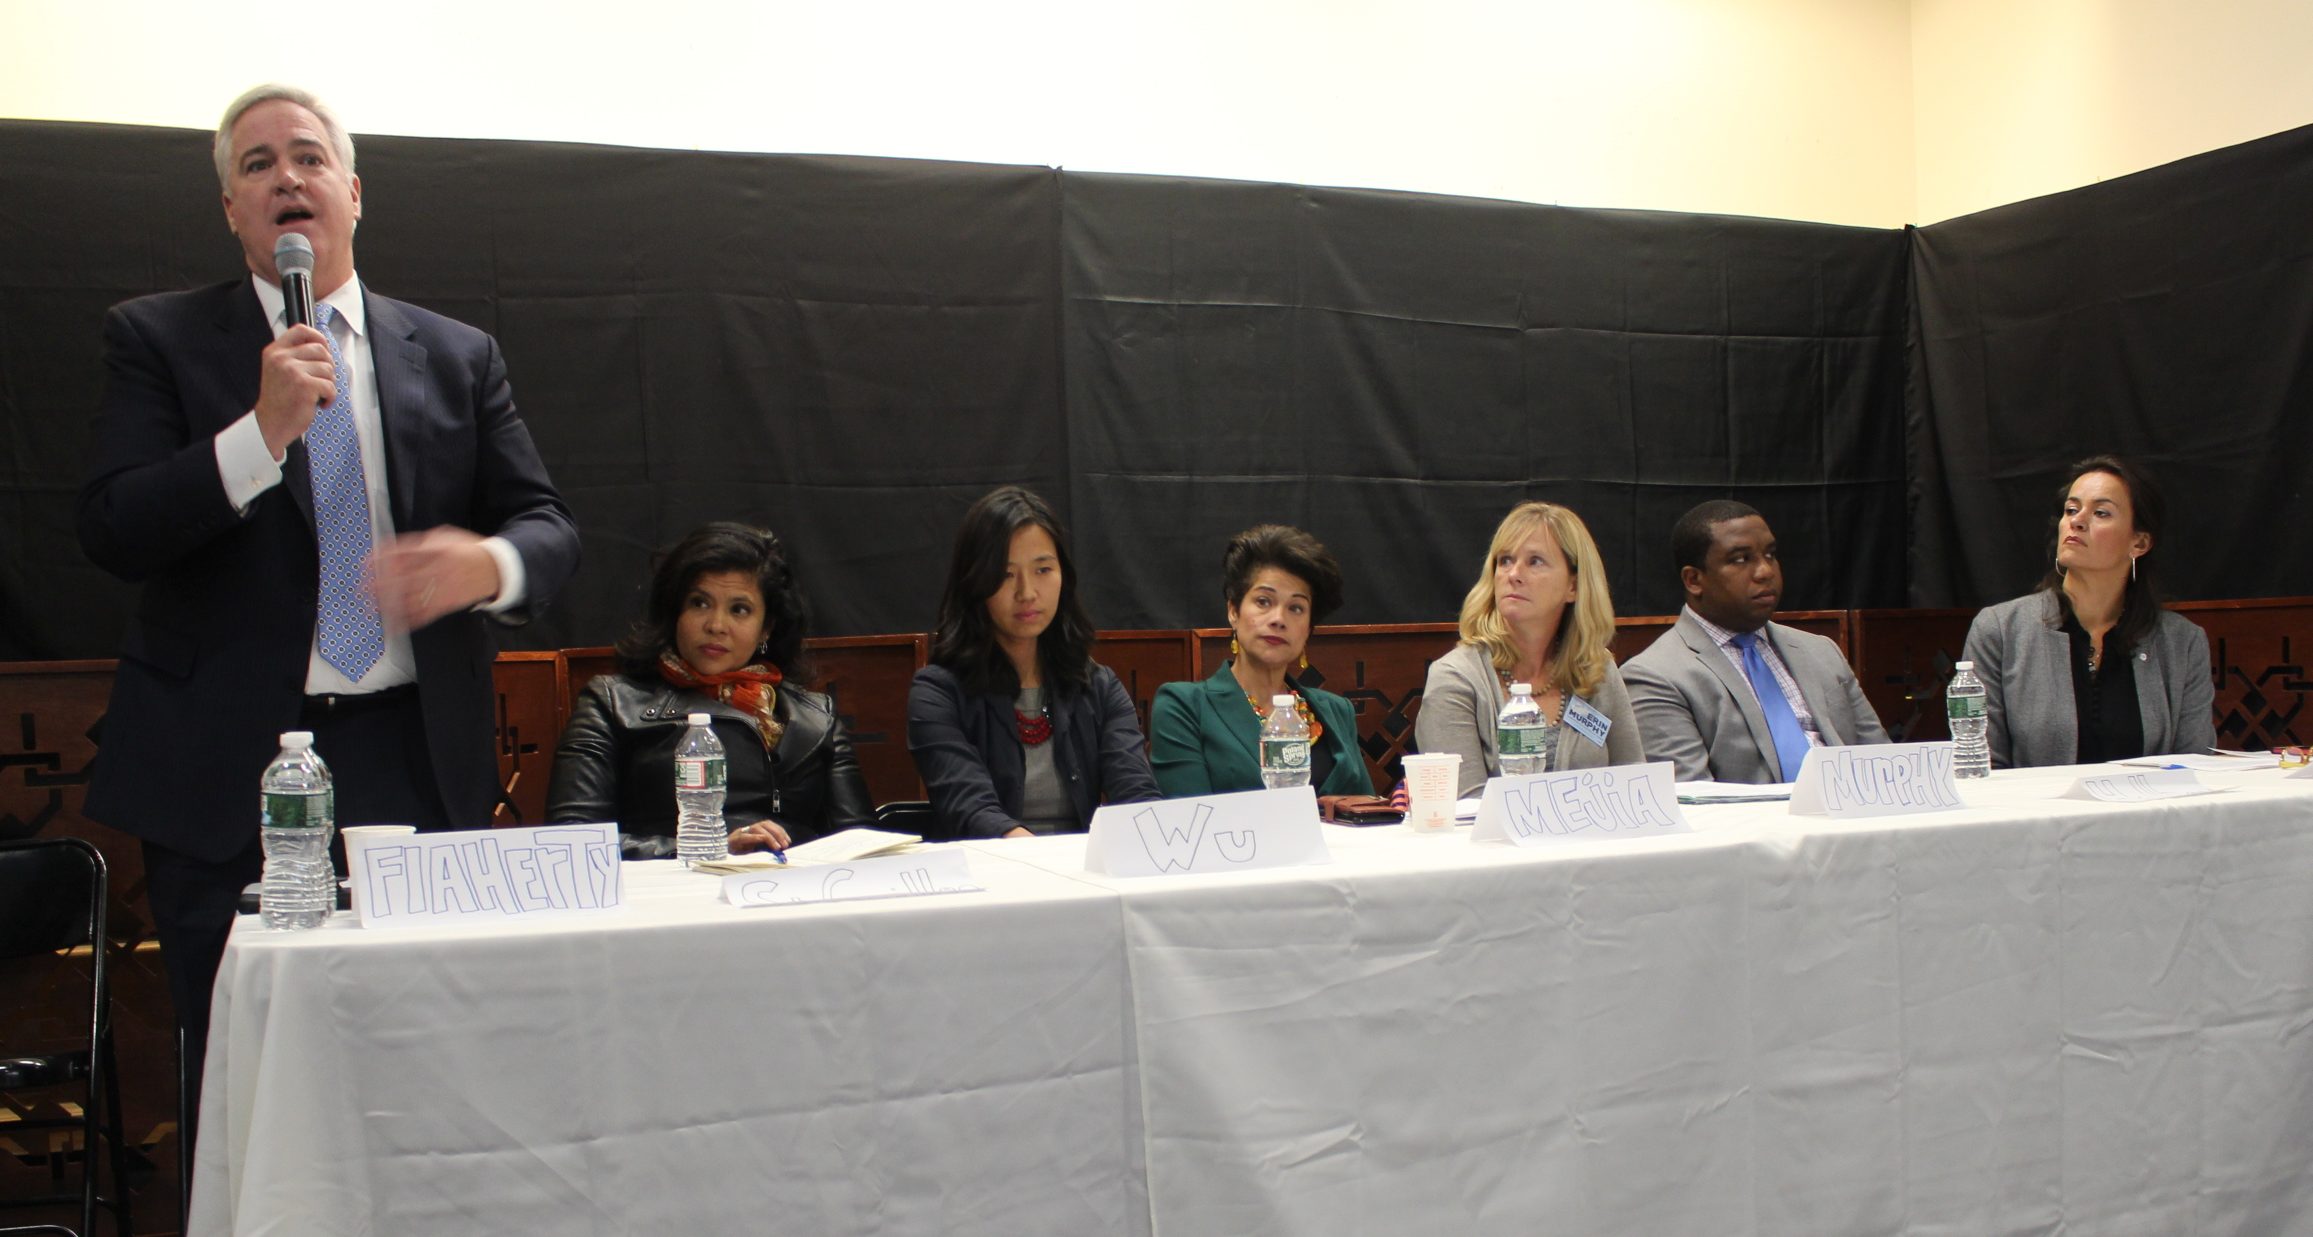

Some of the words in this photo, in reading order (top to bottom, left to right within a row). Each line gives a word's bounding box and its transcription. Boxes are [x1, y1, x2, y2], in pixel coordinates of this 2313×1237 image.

[1569, 709, 1606, 737] MURPHY
[1587, 713, 1608, 731] ERIN
[1132, 803, 1257, 873] Wu
